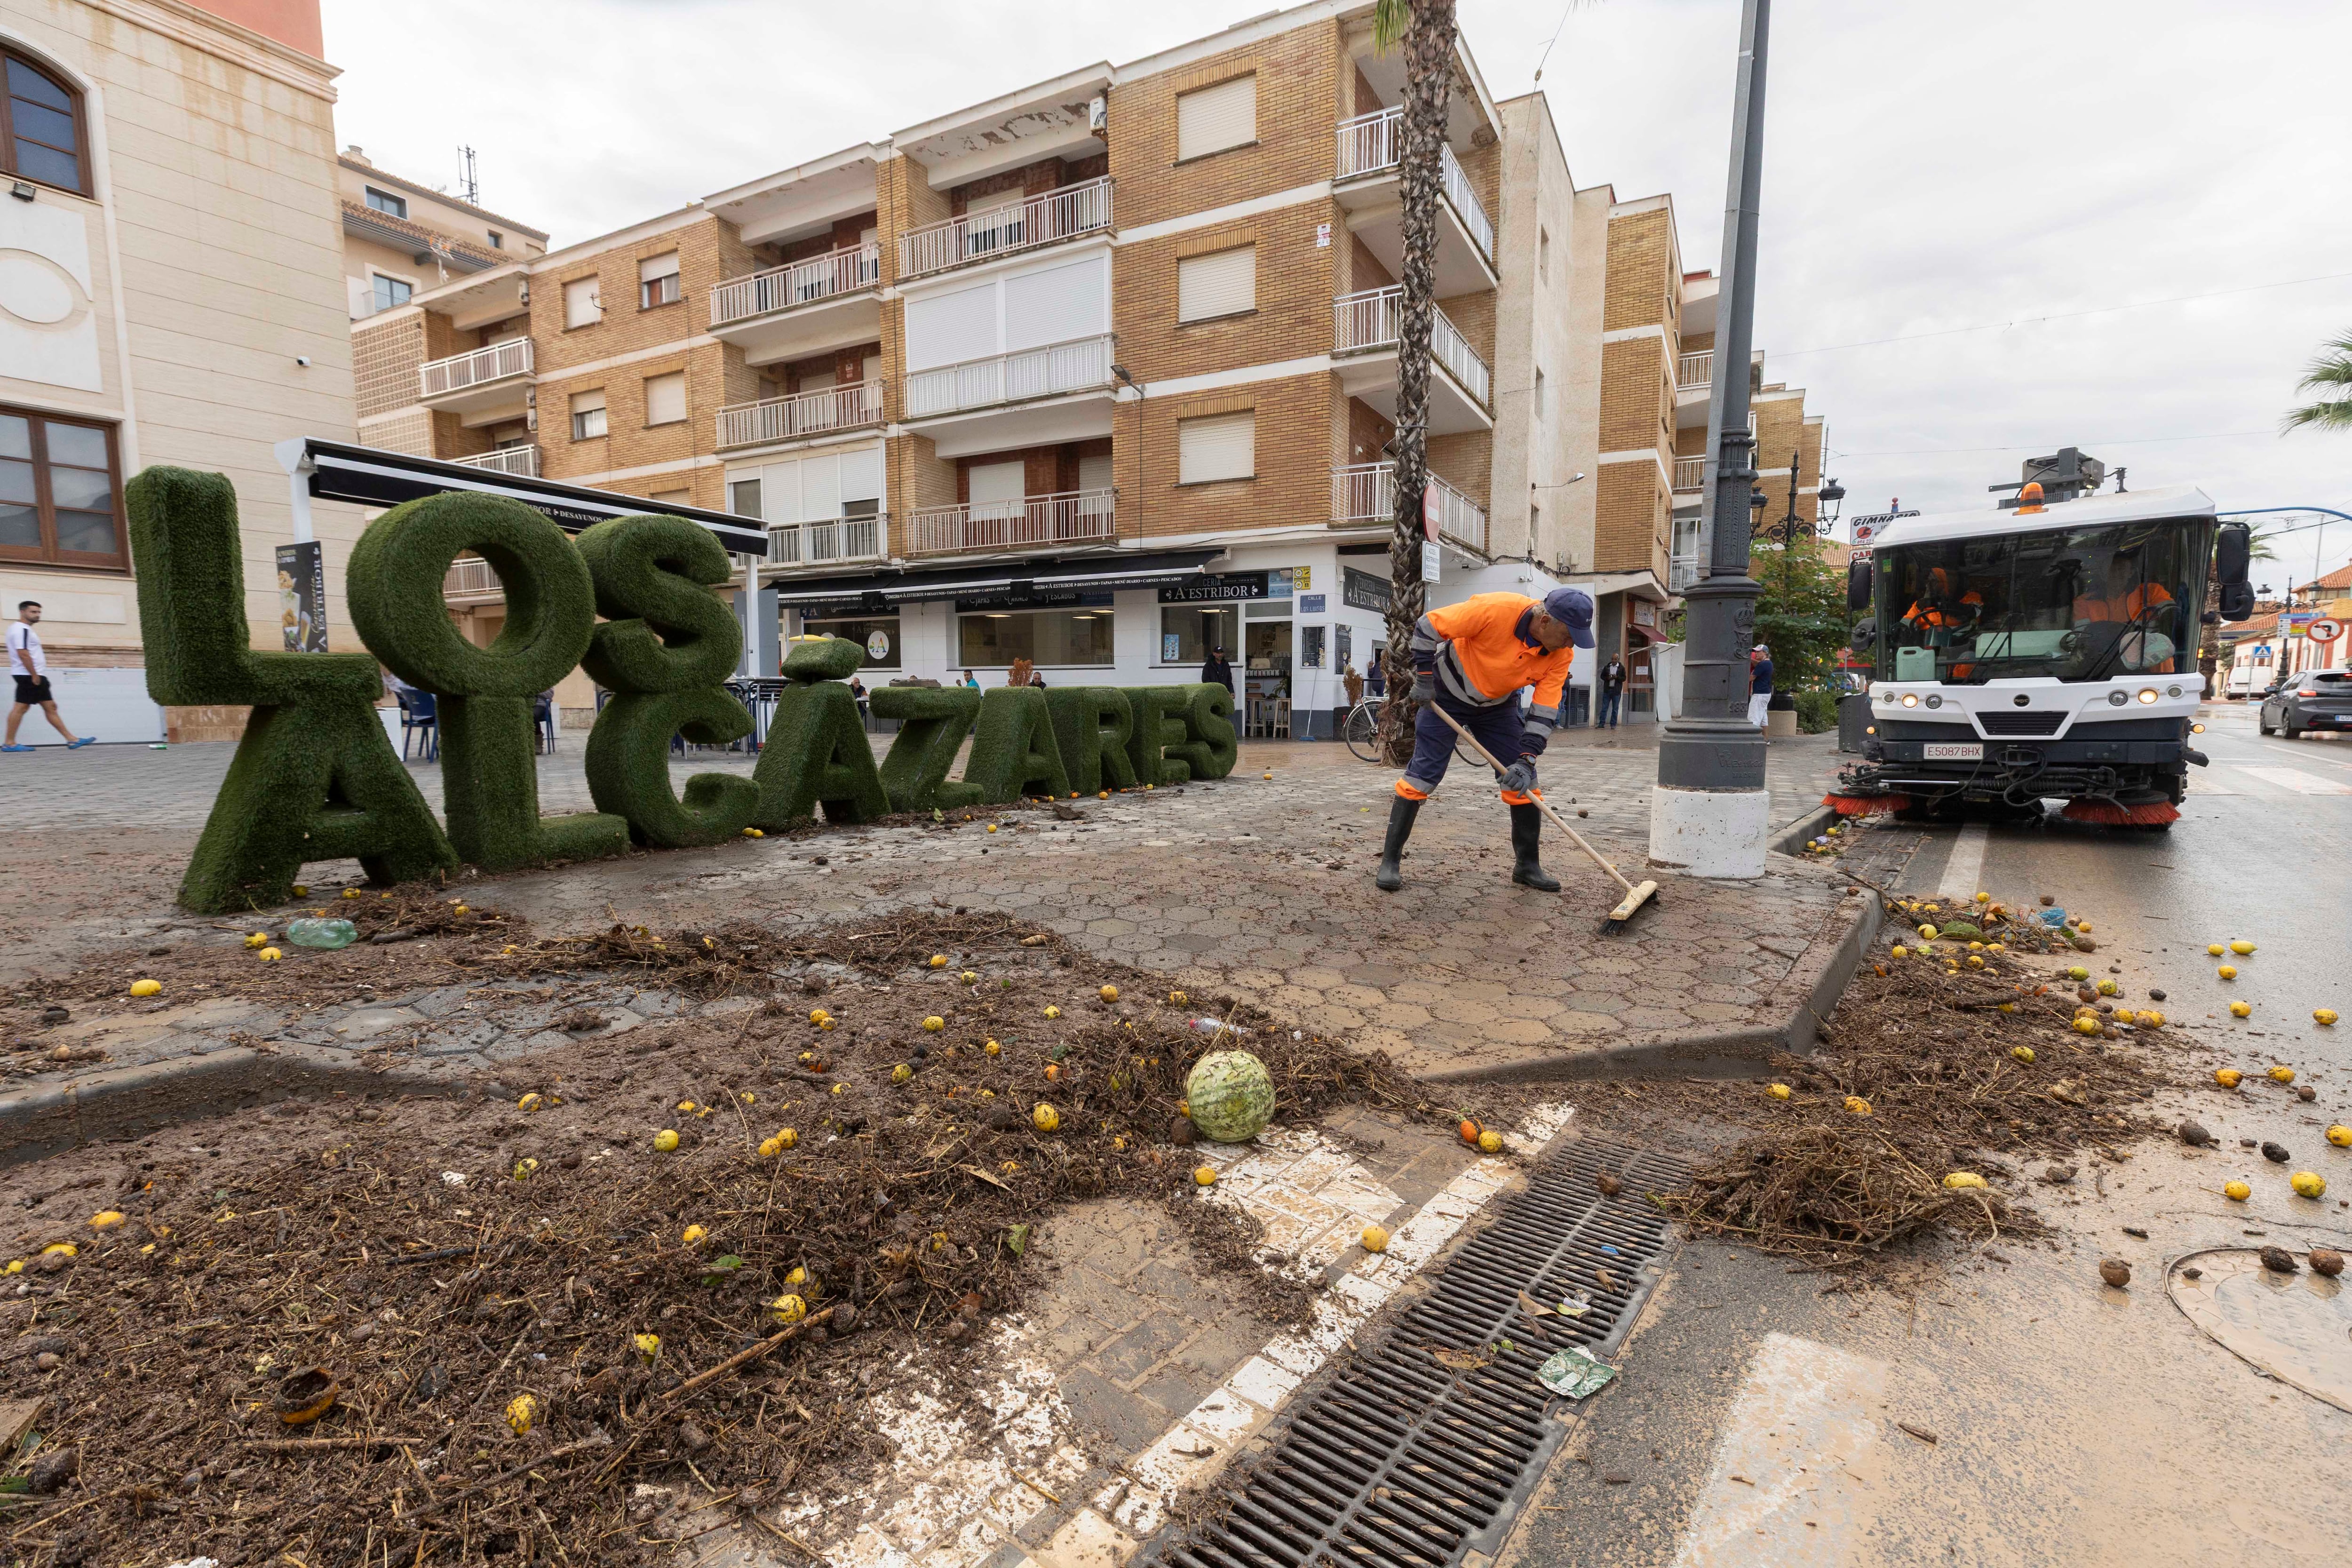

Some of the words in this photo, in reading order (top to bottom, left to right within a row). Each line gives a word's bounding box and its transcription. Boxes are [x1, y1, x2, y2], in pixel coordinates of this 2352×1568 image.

[560, 510, 603, 523] DESAYUNOS
[125, 465, 742, 706] LOS
[1174, 587, 1185, 599] A
[1189, 585, 1248, 599] ESTRIBOR
[1352, 585, 1359, 603] A
[1360, 590, 1386, 610] ESTRIBOR
[875, 637, 887, 653] A
[176, 637, 1239, 916] ALCÁZARES
